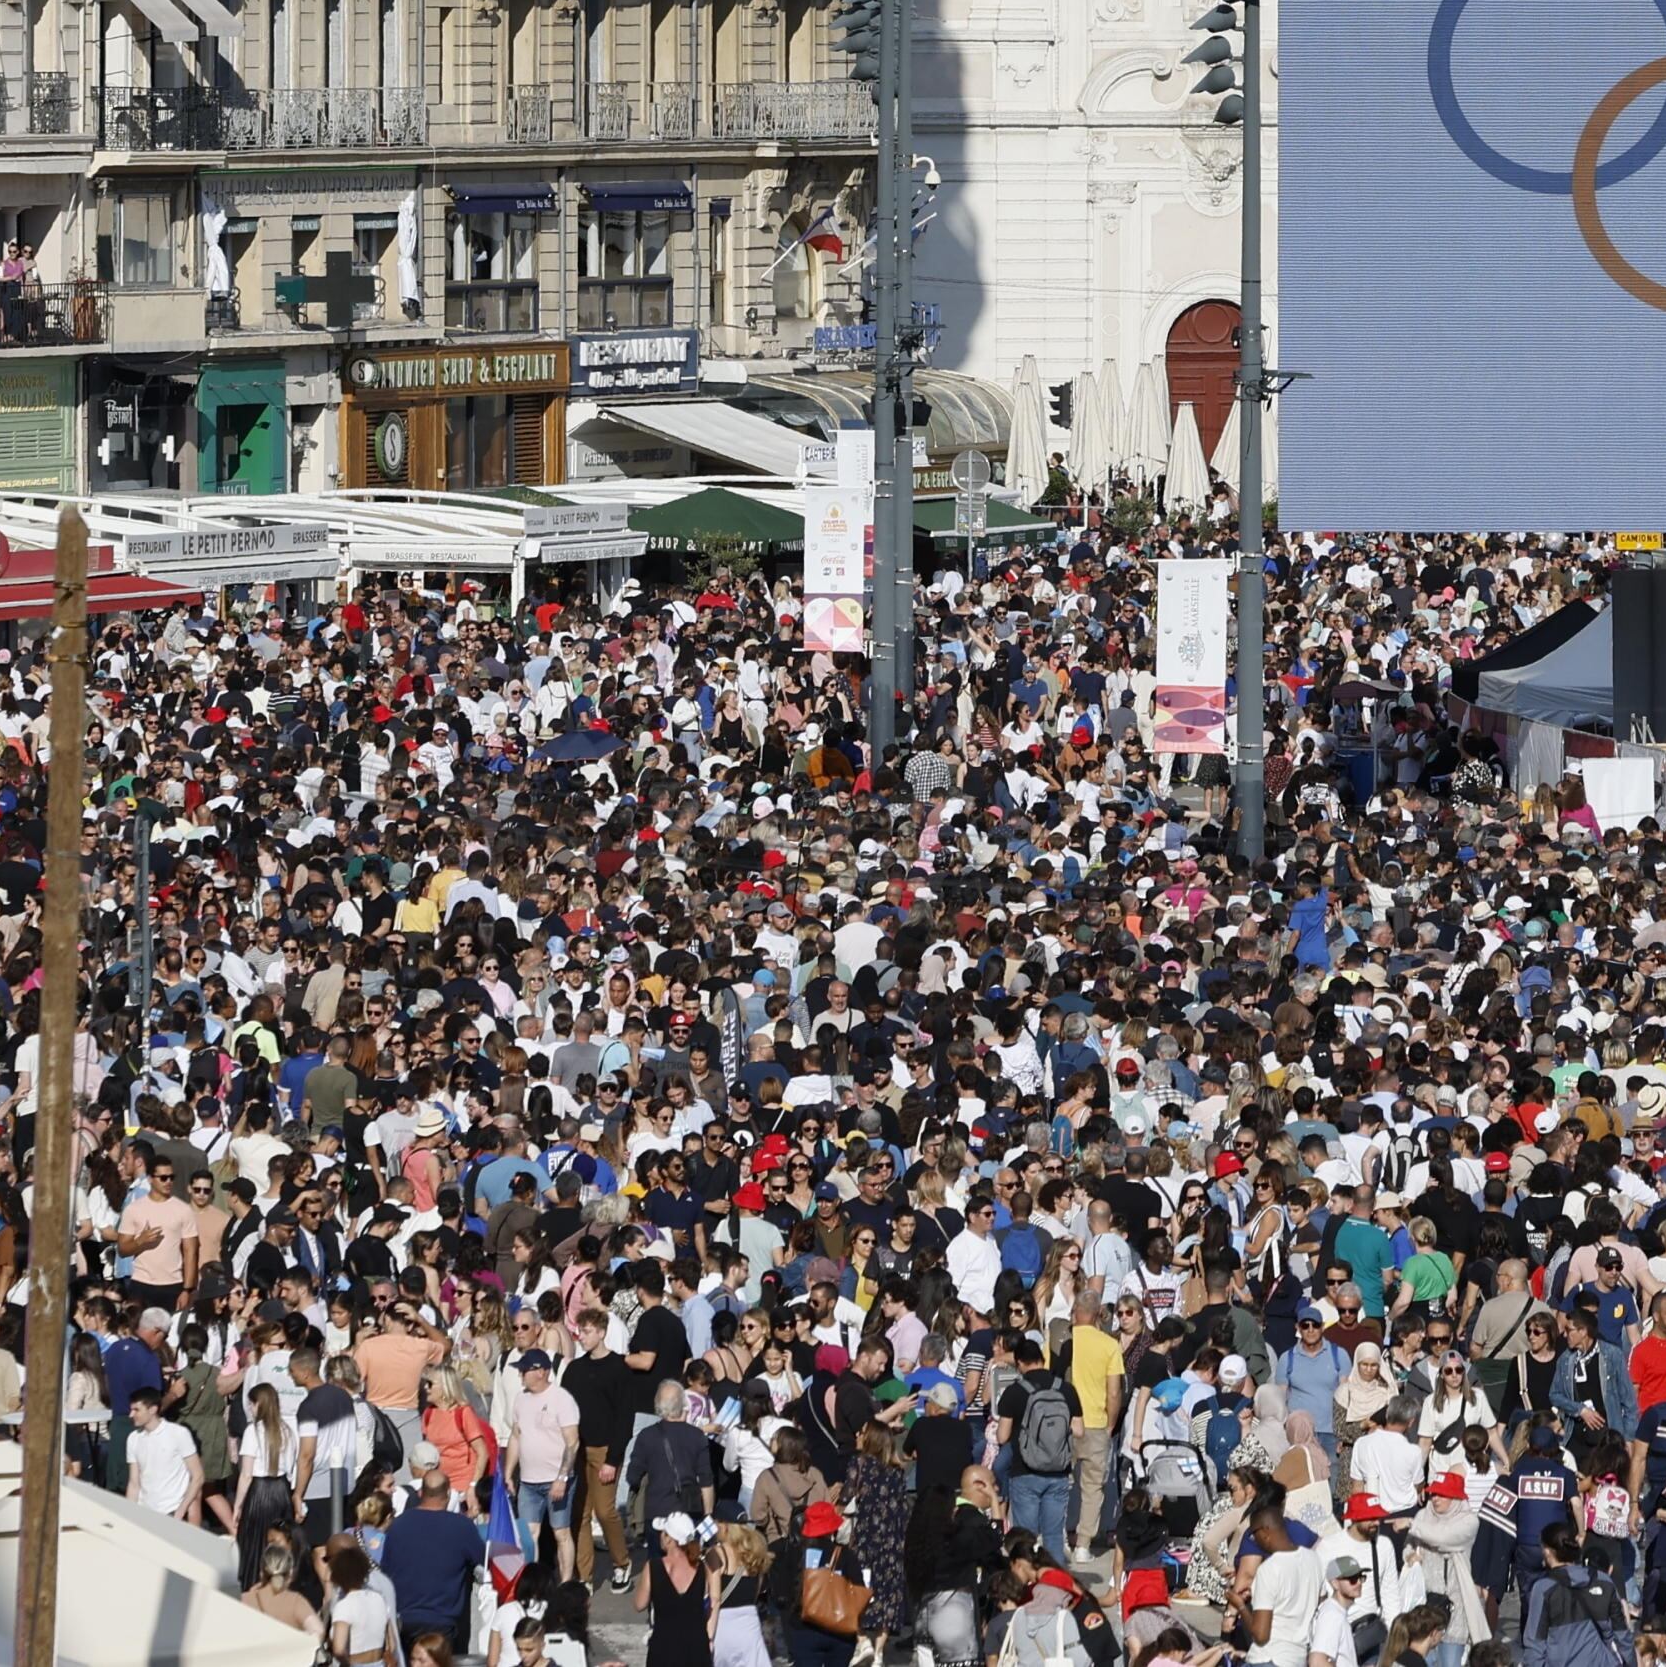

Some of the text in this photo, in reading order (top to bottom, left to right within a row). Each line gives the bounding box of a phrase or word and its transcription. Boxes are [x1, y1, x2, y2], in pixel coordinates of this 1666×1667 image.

[579, 337, 690, 367] RESTAURANT
[442, 356, 473, 386] SHOP
[480, 357, 489, 383] &
[494, 353, 557, 381] EGGPLANT
[128, 539, 172, 555] RESTAURANT
[182, 534, 194, 555] LE
[197, 532, 228, 555] PETIT
[292, 529, 327, 544] BRASSERIE
[649, 537, 679, 551] SHOP
[1620, 535, 1658, 543] CAMIONS
[385, 551, 478, 561] BRASSERIE RESTAURANT
